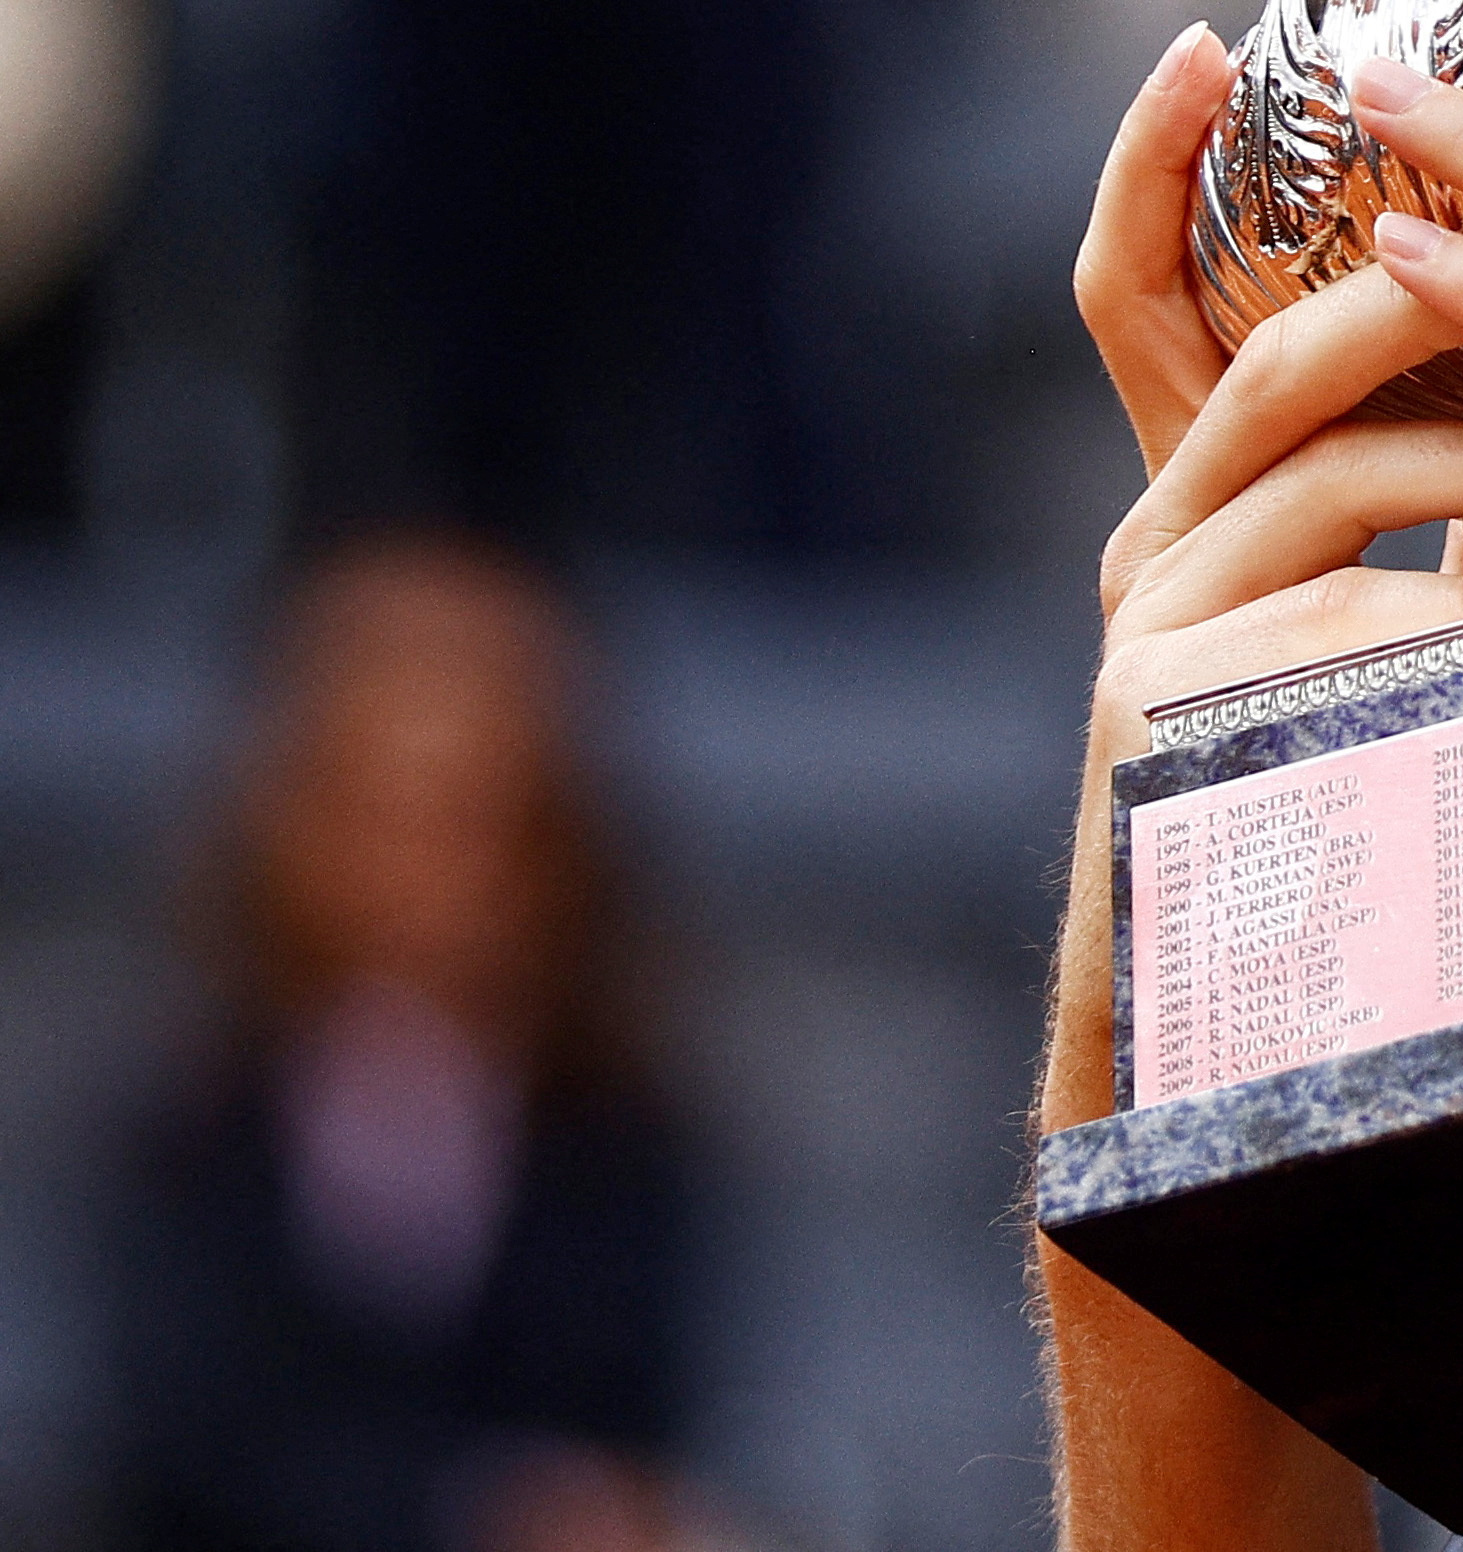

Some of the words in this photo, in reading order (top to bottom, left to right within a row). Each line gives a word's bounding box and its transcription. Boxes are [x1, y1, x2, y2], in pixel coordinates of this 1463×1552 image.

[1154, 818, 1190, 843] 1996
[1207, 809, 1221, 828] T.
[1226, 787, 1303, 823] MUSTER
[1308, 771, 1358, 801] (AUT)
[1154, 837, 1190, 863] 1997
[1205, 828, 1222, 849] A.
[1228, 804, 1313, 843] CORTEJA
[1318, 789, 1363, 819] (ESP)
[1155, 857, 1191, 882] 1998
[1206, 847, 1226, 868] M.
[1233, 834, 1275, 861] RIOS
[1280, 819, 1327, 849] (CHI)
[1155, 876, 1191, 901] 1999
[1206, 867, 1224, 887] G.
[1230, 841, 1317, 881] KUERTEN
[1323, 826, 1373, 856] (BRA)
[1155, 896, 1191, 921] 2000
[1206, 886, 1227, 907] M.
[1232, 862, 1315, 900] NORMAN
[1320, 846, 1372, 877] (SWE)
[1156, 915, 1192, 941] 2001
[1206, 908, 1219, 927] J.
[1225, 882, 1312, 922] FERRERO
[1317, 868, 1362, 898] (ESP)
[1156, 935, 1192, 961] 2002
[1207, 926, 1224, 947] A.
[1229, 906, 1296, 940] AGASSI
[1301, 892, 1348, 922] (USA)
[1156, 955, 1192, 980] 2003
[1207, 947, 1222, 966] F.
[1228, 918, 1326, 960] MANTILLA
[1331, 904, 1376, 933] (ESP)
[1157, 974, 1193, 1000] 2004
[1208, 966, 1224, 986] C.
[1229, 948, 1286, 980] MOYA
[1291, 934, 1336, 964] (ESP)
[1157, 994, 1193, 1019] 2005
[1208, 985, 1224, 1005] R.
[1229, 966, 1293, 999] NADAL
[1298, 952, 1344, 981] (ESP)
[1157, 1013, 1193, 1039] 2006
[1208, 1005, 1225, 1025] R.
[1230, 986, 1294, 1019] NADAL
[1298, 972, 1344, 1002] (ESP)
[1158, 1033, 1194, 1059] 2007
[1209, 1024, 1225, 1045] R.
[1230, 1005, 1294, 1039] NADAL
[1298, 991, 1344, 1021] (ESP)
[1158, 1052, 1194, 1079] 2008
[1208, 1044, 1225, 1065] N.
[1231, 1017, 1325, 1059] DJOKOVIC
[1332, 1001, 1379, 1032] (SRB)
[1158, 1072, 1194, 1098] 2009
[1209, 1064, 1226, 1084] R.
[1231, 1045, 1295, 1078] NADAL
[1299, 1030, 1345, 1060] (ESP)
